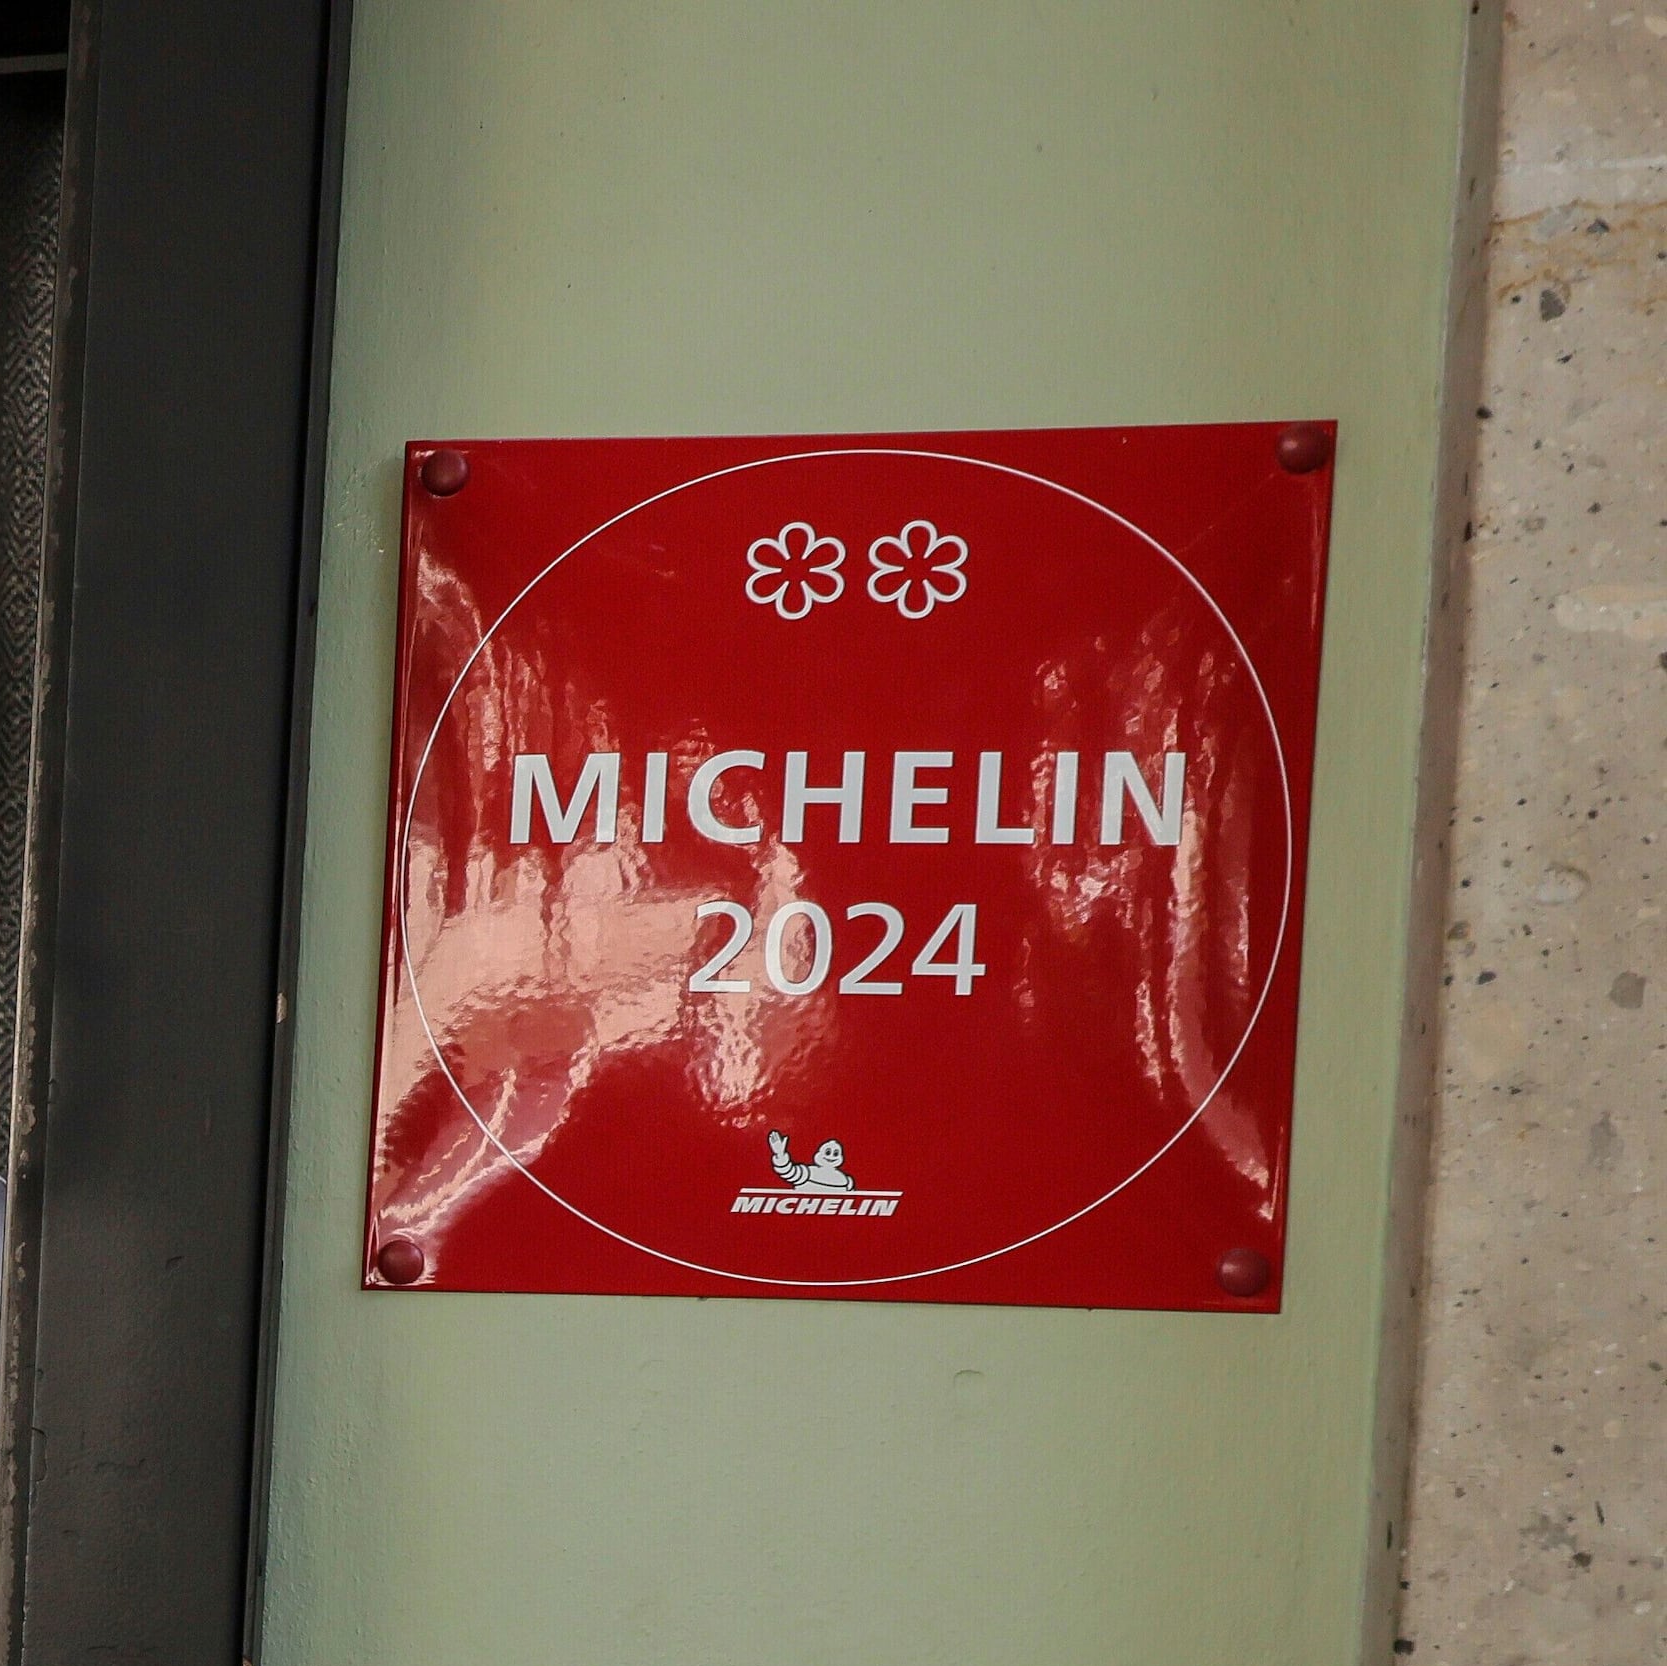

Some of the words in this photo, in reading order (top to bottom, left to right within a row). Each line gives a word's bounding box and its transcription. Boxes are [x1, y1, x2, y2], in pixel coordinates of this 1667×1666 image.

[509, 749, 1187, 846] MICHELIN
[687, 902, 987, 997] 2024
[730, 1196, 899, 1217] MICHELIN
